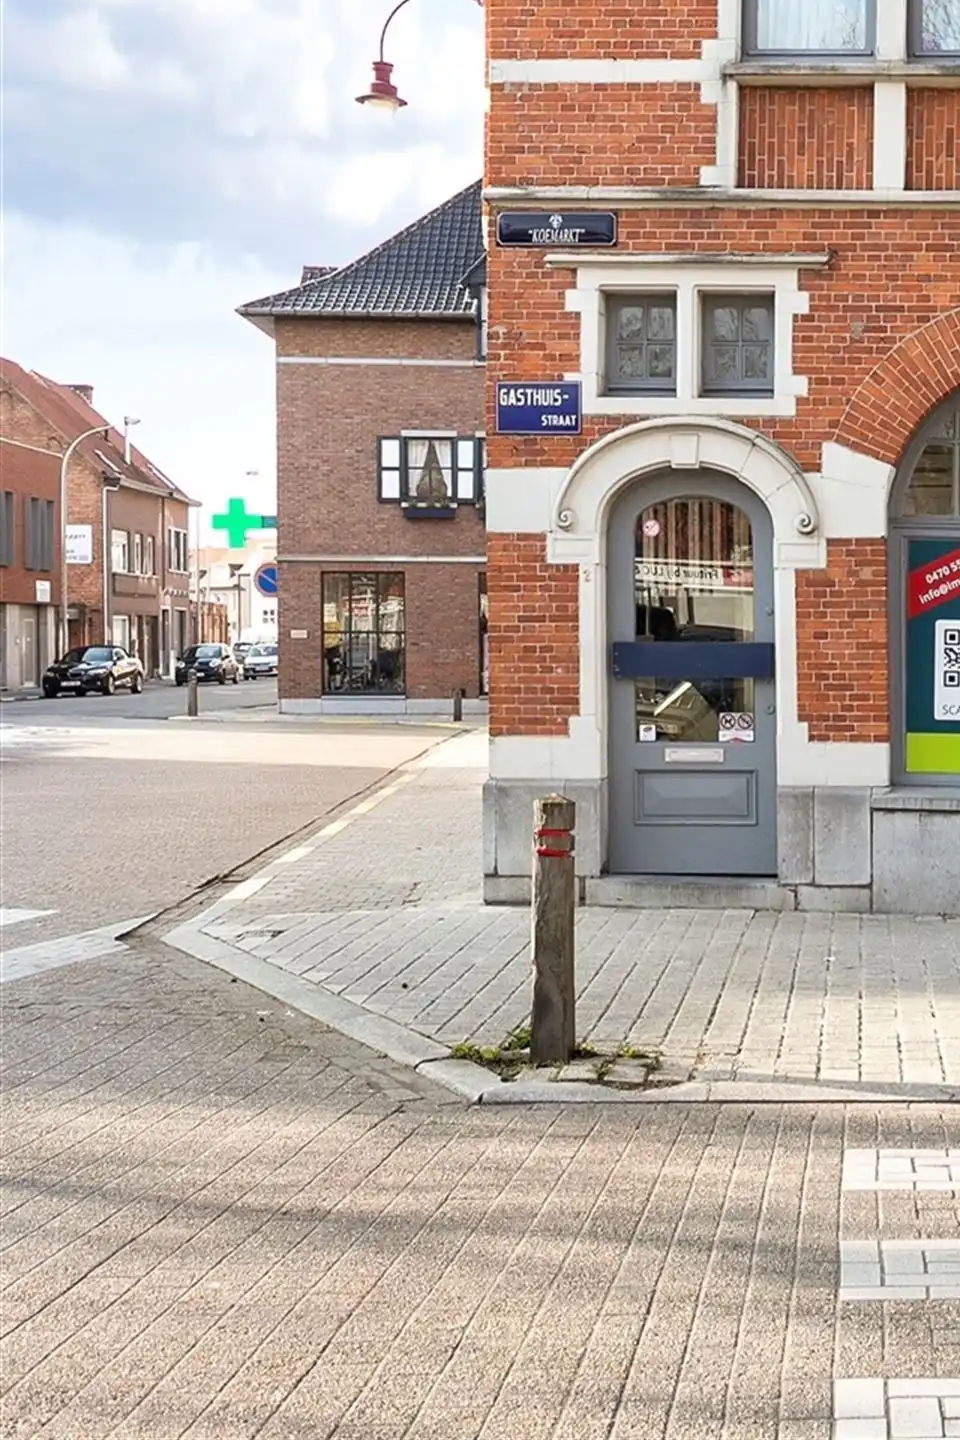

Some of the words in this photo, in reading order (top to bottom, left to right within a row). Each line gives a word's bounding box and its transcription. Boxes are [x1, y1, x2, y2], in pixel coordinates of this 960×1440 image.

[499, 388, 570, 406] GASTHUIS-
[541, 414, 577, 427] STRAAT
[925, 565, 950, 584] 0470
